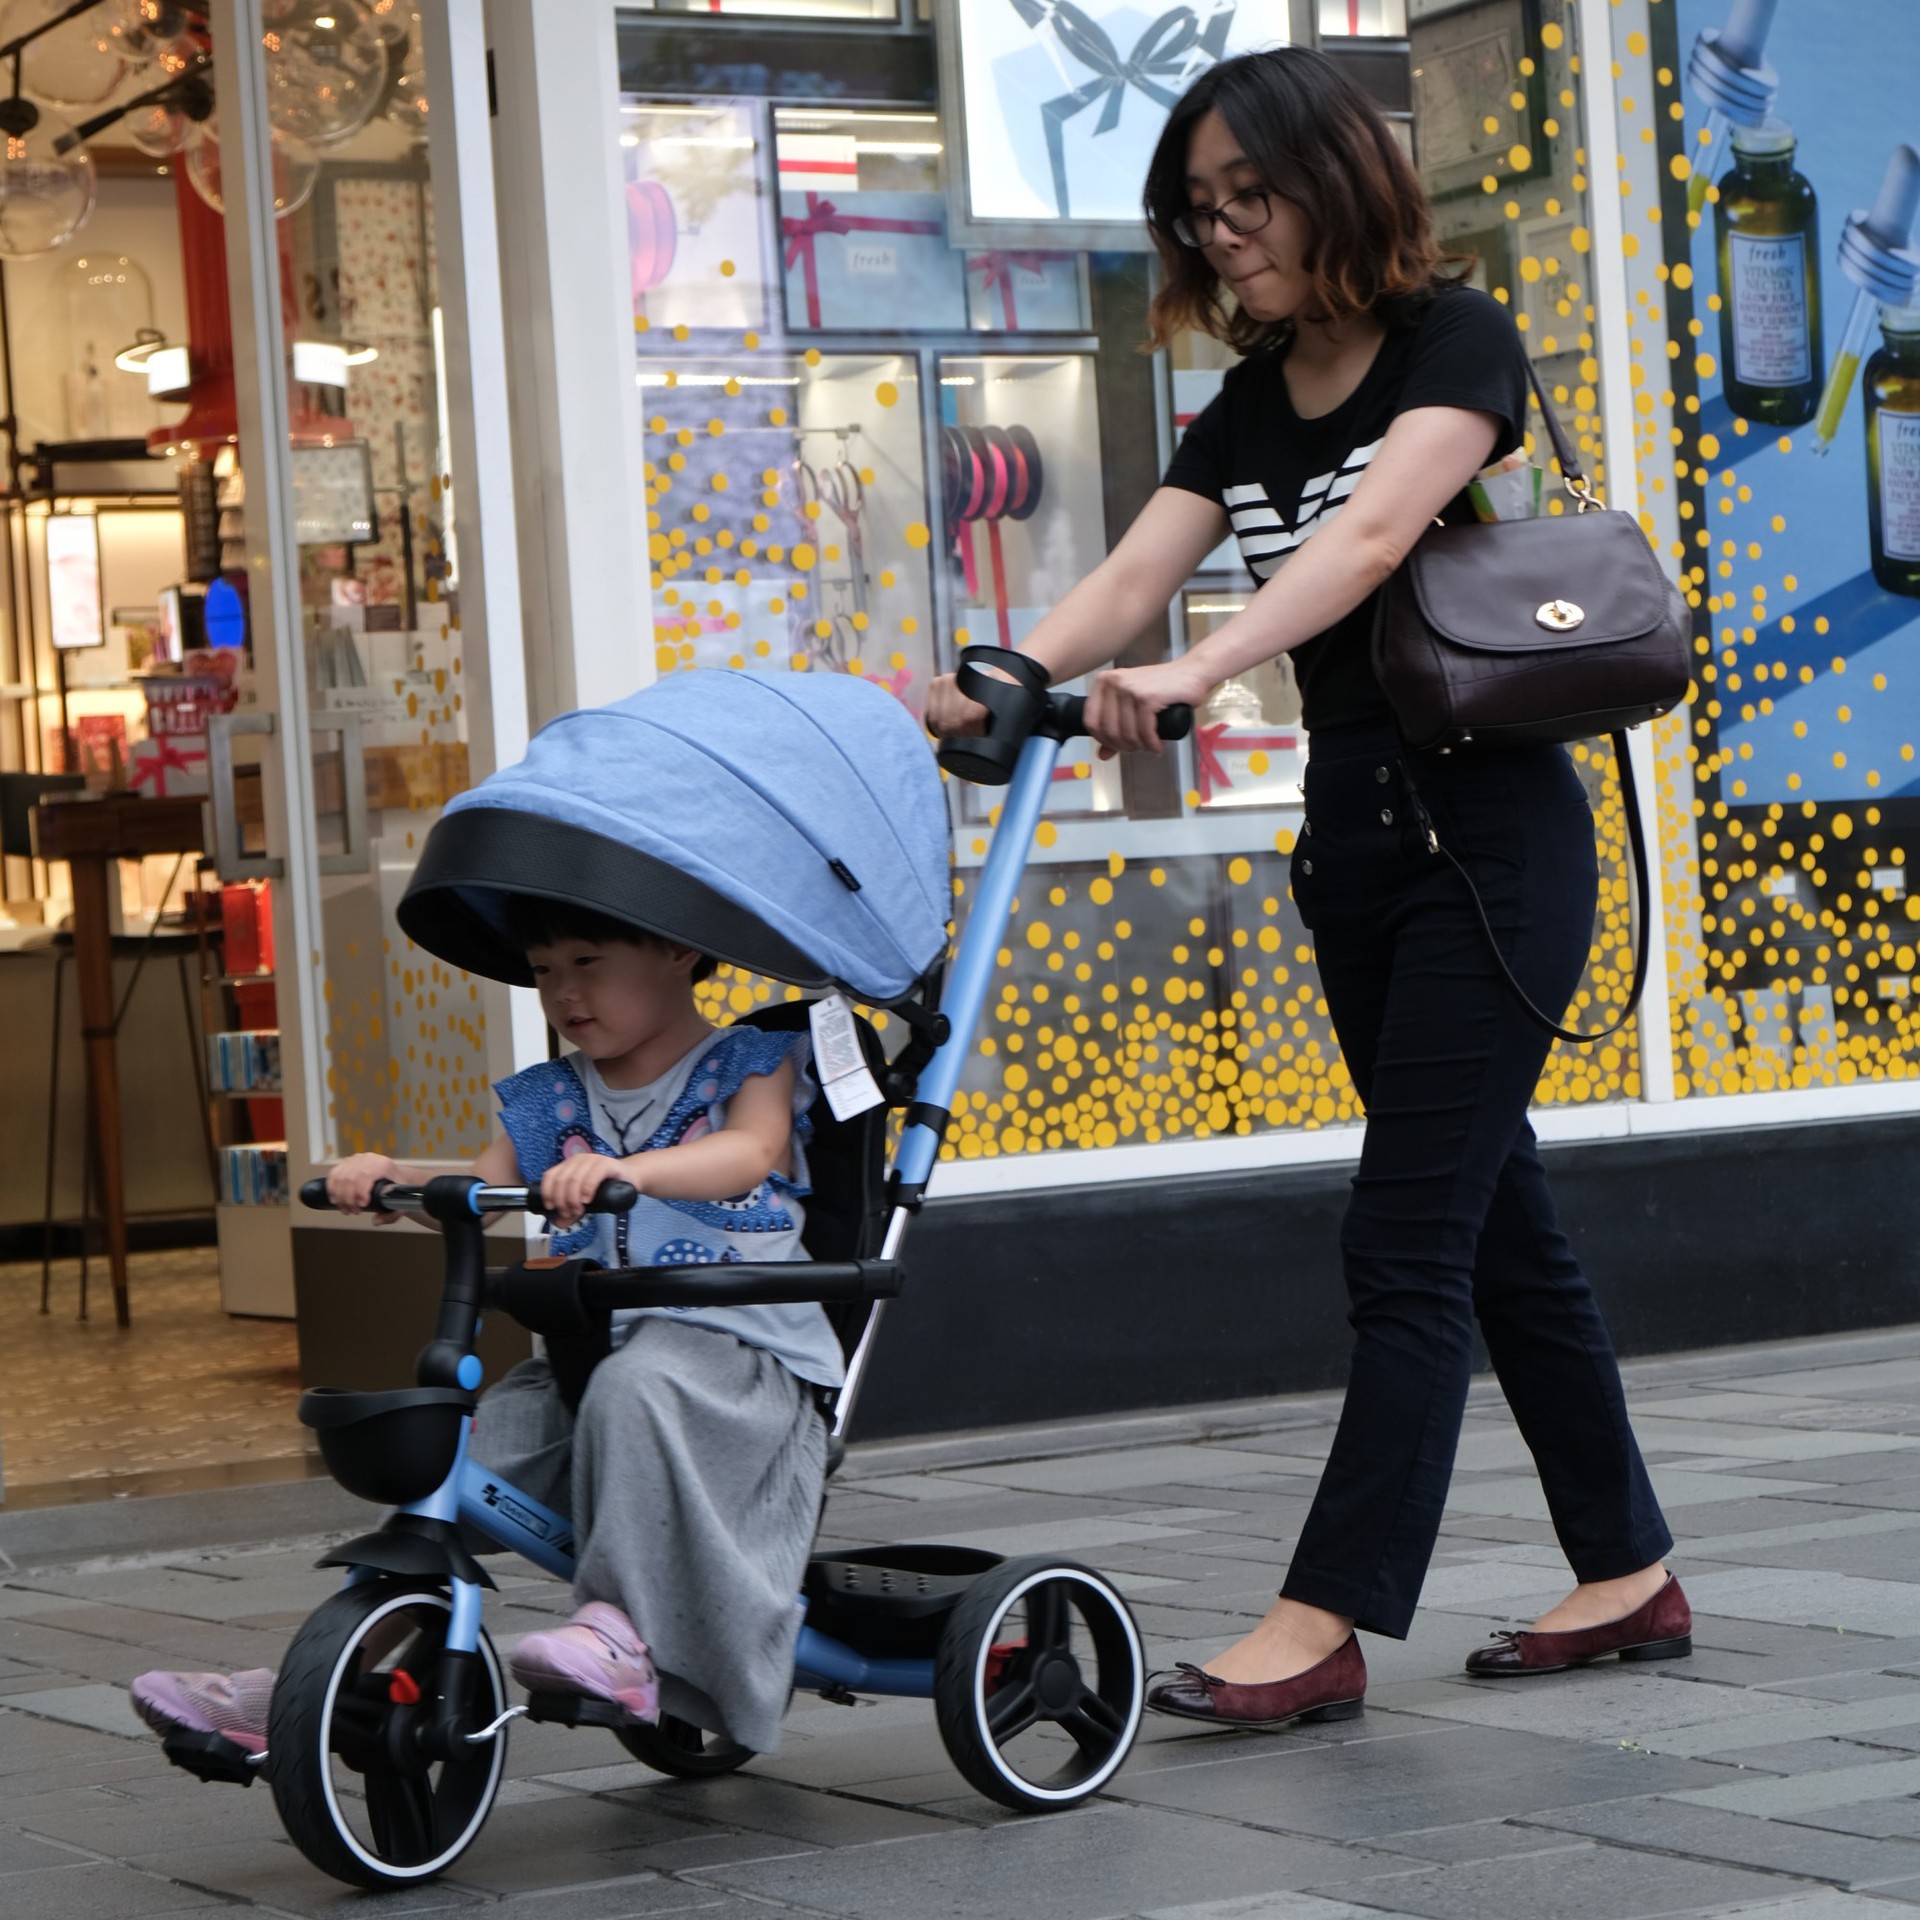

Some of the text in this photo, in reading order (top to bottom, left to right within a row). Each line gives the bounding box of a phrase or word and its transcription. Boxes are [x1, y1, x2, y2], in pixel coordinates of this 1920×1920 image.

[851, 252, 891, 270] fresh
[1748, 244, 1787, 262] fresh
[1743, 265, 1794, 279] VITAMIN
